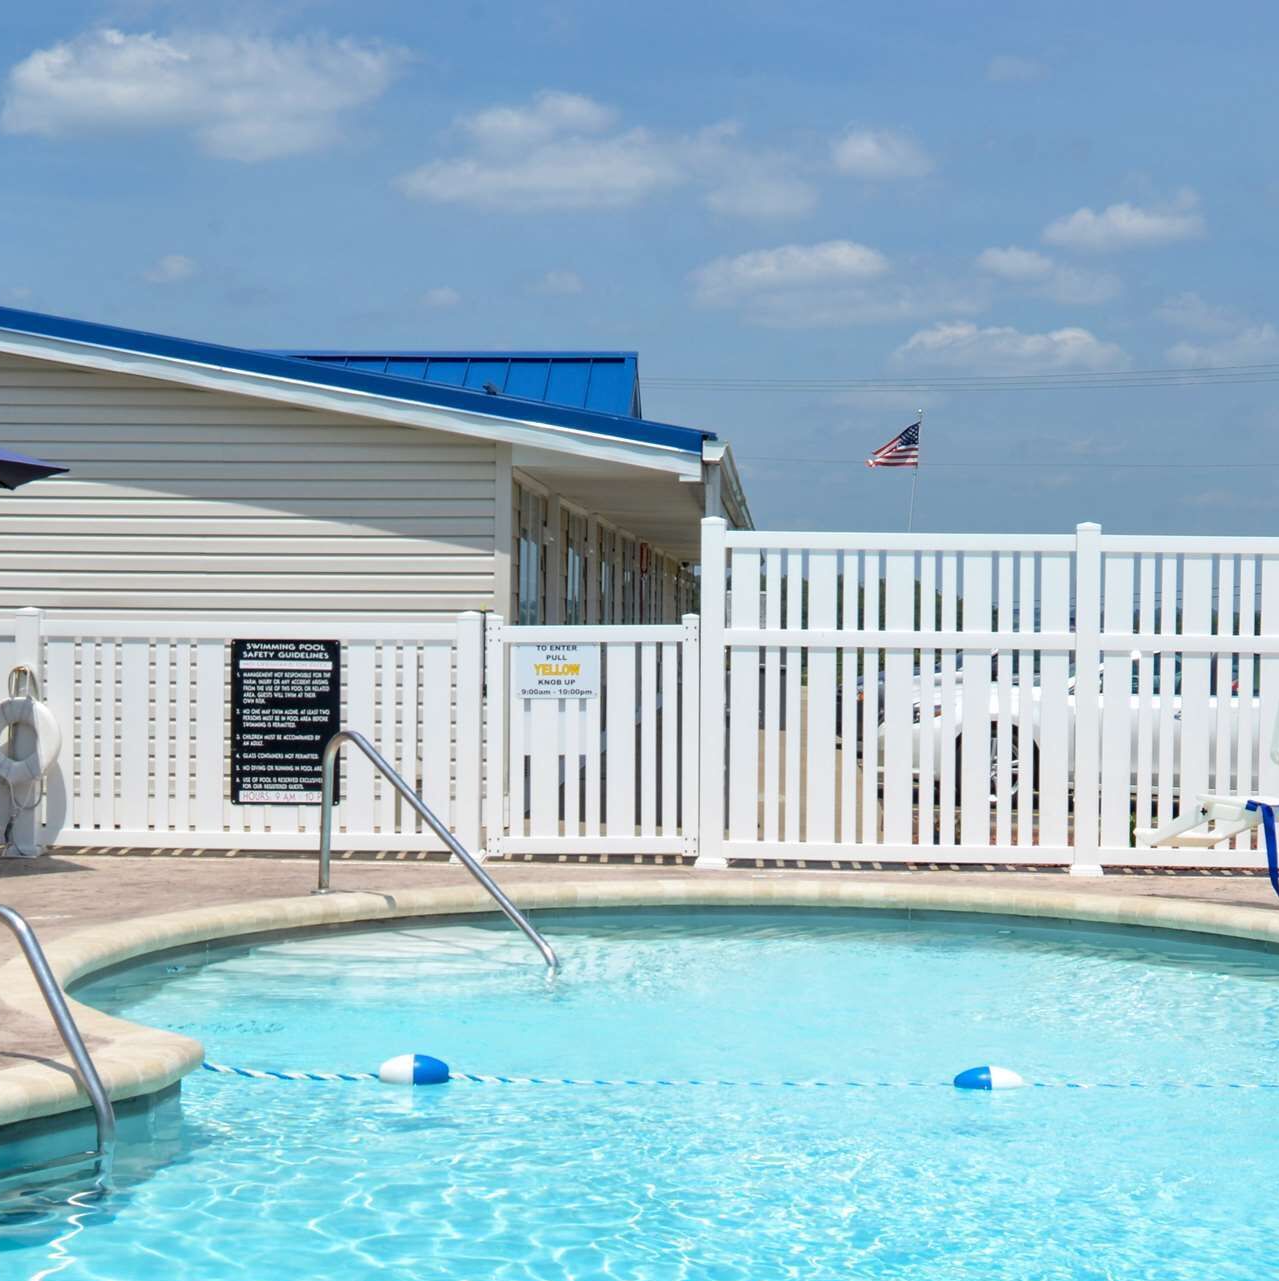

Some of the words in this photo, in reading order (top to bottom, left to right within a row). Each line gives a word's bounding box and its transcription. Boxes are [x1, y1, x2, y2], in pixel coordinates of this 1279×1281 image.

[534, 664, 580, 676] YELLOW
[276, 791, 280, 800] 9
[283, 791, 296, 800] AM
